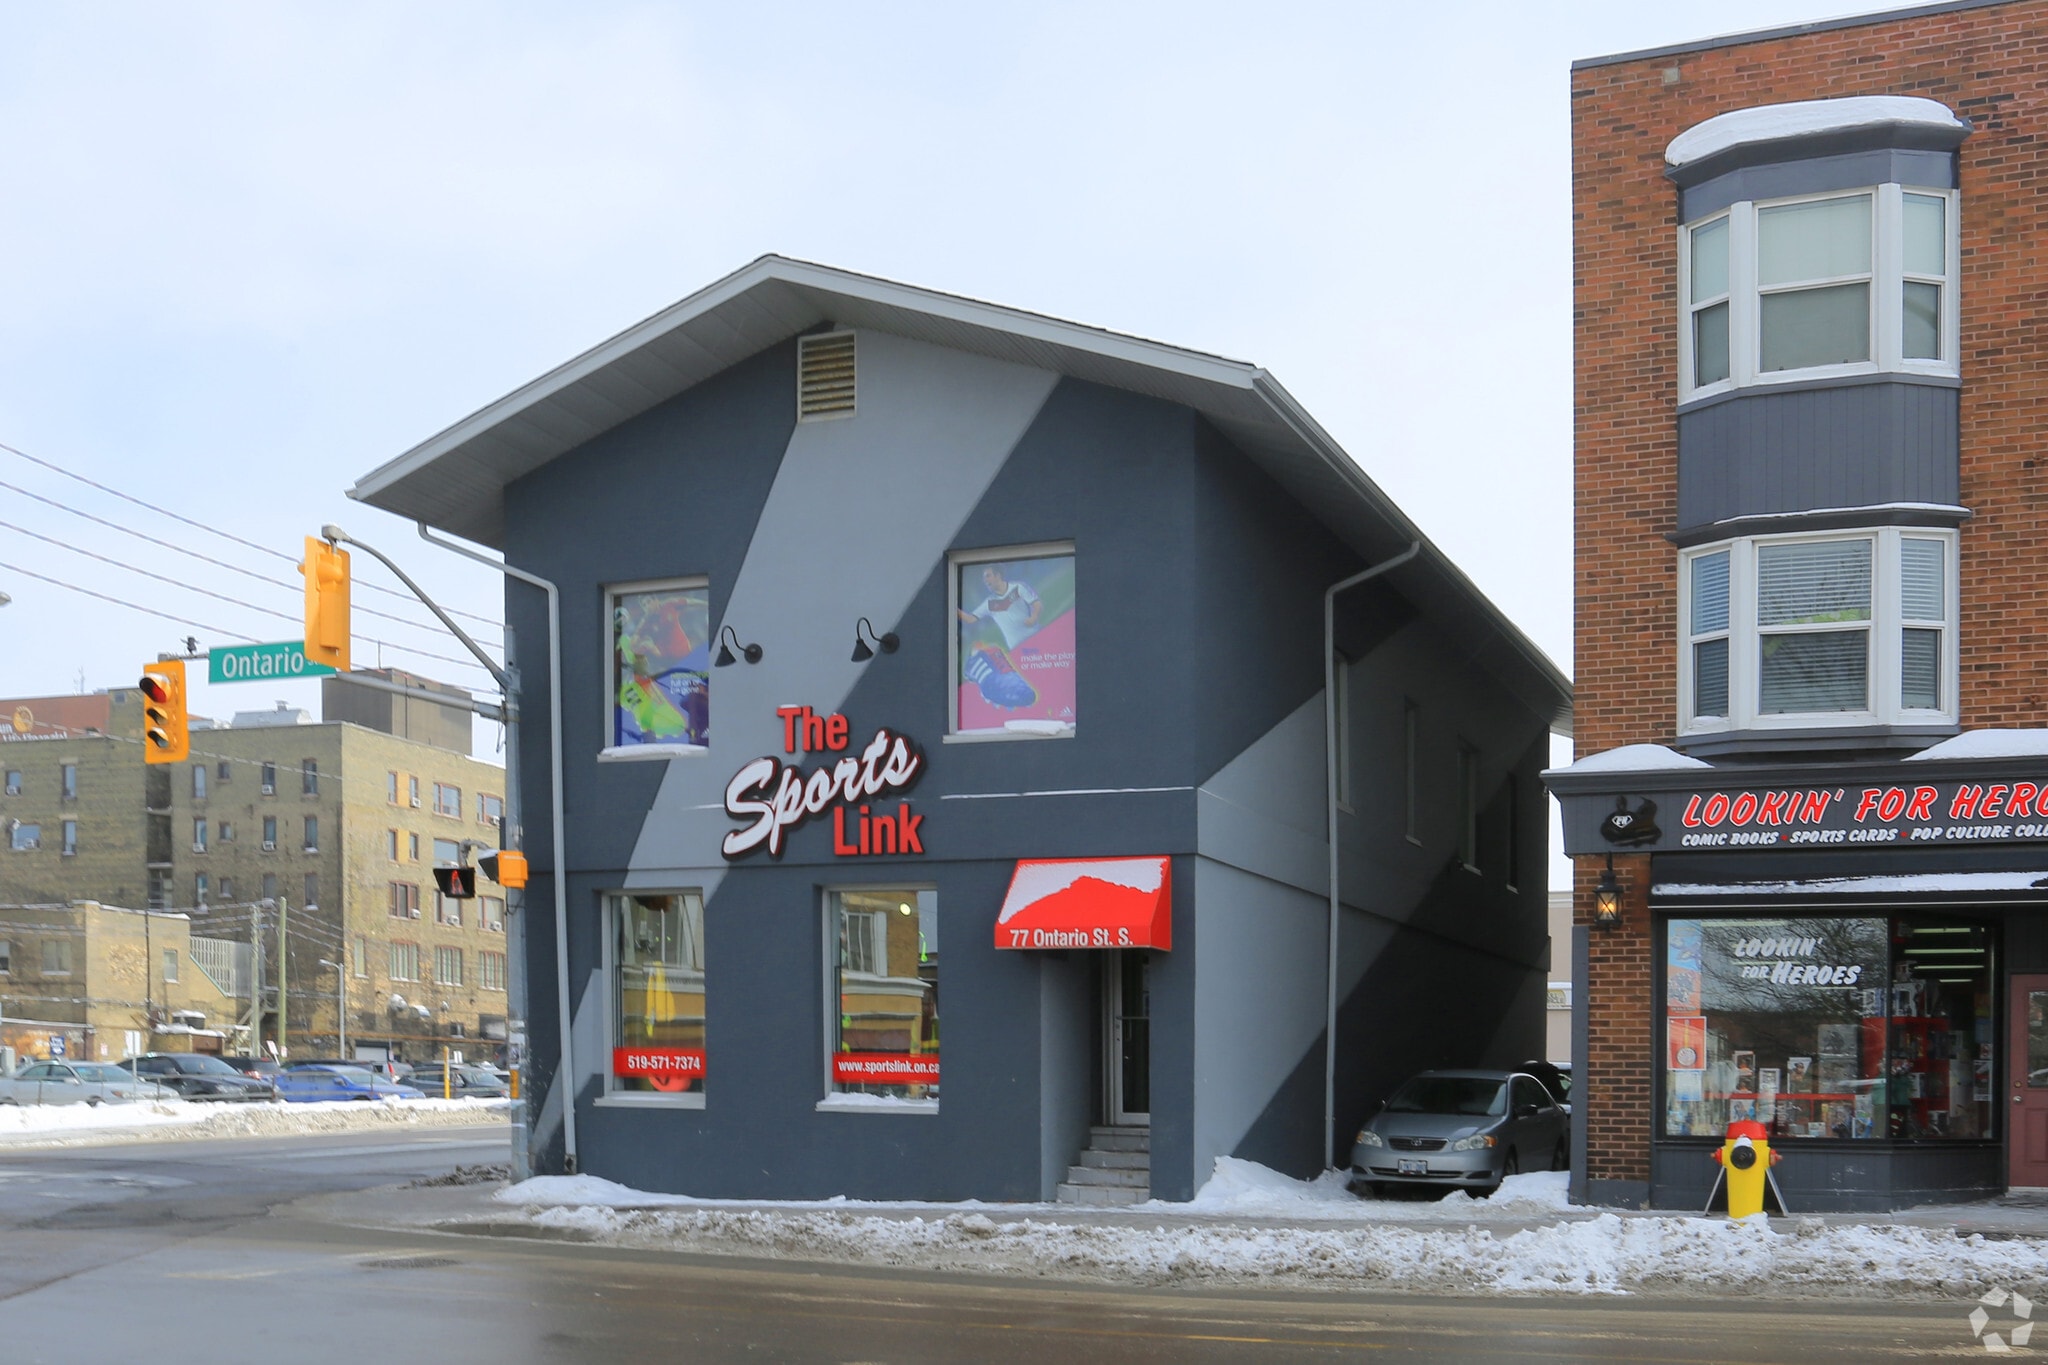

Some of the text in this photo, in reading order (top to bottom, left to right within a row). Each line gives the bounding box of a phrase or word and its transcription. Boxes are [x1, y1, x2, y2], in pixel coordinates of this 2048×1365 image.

[222, 646, 305, 678] Ontario
[777, 705, 849, 753] The
[723, 729, 921, 856] Sports
[1682, 788, 1845, 828] LOOKIN'
[1854, 786, 1939, 822] FOR
[834, 804, 924, 856] Link
[1681, 833, 1728, 847] COMIC
[1729, 831, 1779, 846] BOOKS
[1789, 829, 1847, 845] SPORTS
[1848, 828, 1899, 842] CARDS
[1910, 827, 1944, 841] POP
[1945, 825, 2013, 840] CULTURE
[1009, 927, 1134, 947] 77 Ontario St. S.
[1735, 937, 1823, 957] LOOKIN'
[1741, 960, 1862, 985] FOR HEROES
[627, 1054, 701, 1070] 519-571-7374
[838, 1060, 940, 1075] www.sportslink.on.ca
